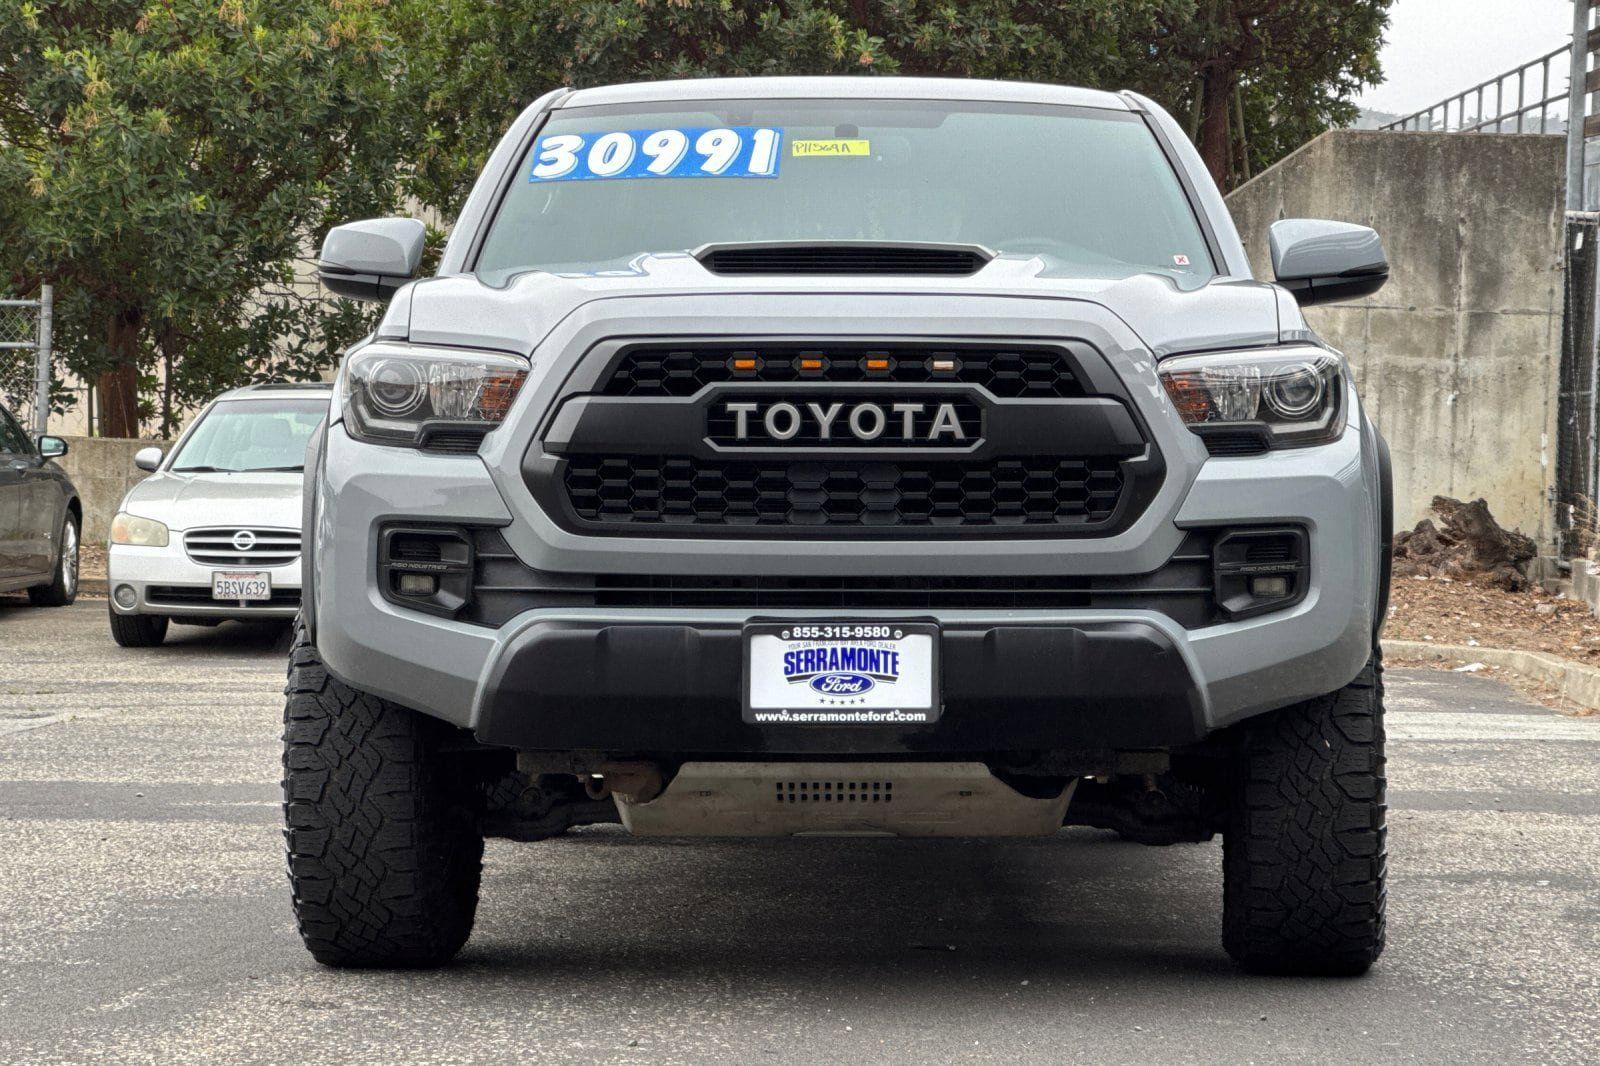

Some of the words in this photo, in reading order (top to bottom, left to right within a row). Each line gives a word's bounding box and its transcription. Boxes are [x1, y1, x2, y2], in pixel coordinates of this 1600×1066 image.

[532, 128, 779, 179] 30991
[726, 402, 967, 440] TOYOTA
[216, 580, 267, 596] 5BSV639
[792, 626, 891, 638] 855-315-9580
[784, 647, 900, 676] SERRAMONTE
[821, 675, 863, 693] Ford
[755, 710, 926, 722] www.serramonteford.com
